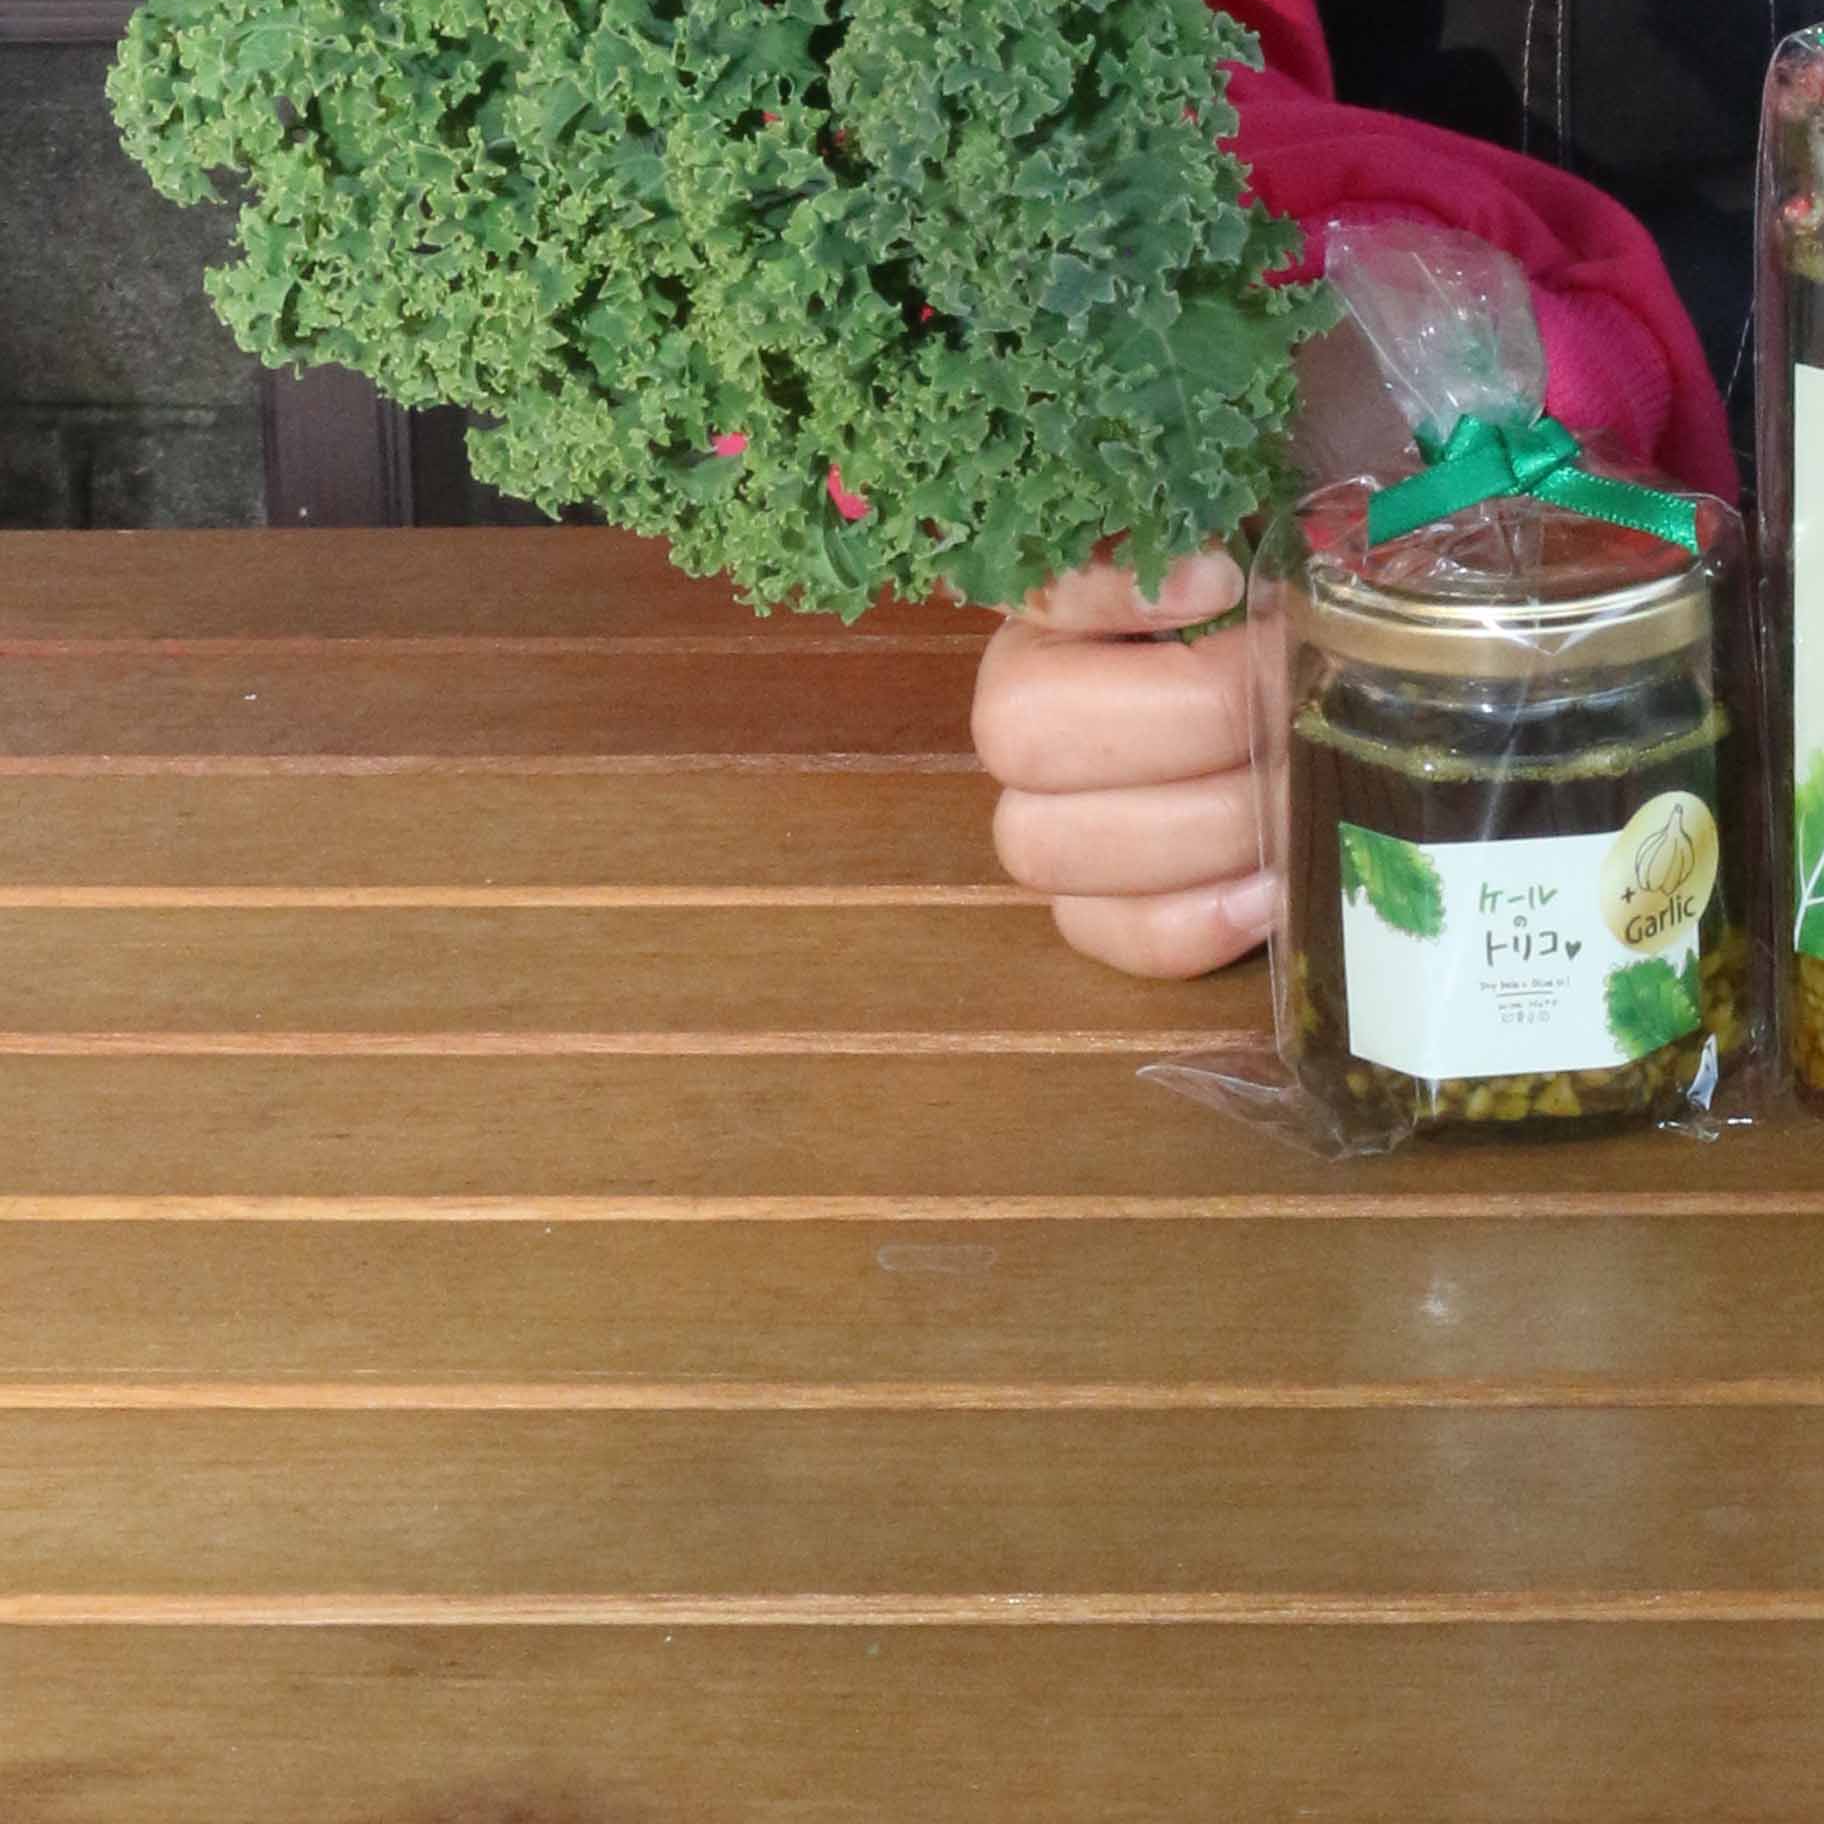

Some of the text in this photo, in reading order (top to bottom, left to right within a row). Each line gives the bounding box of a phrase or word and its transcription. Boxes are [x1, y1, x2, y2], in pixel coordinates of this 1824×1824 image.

[1479, 882, 1558, 913] ケール
[1512, 915, 1528, 928] の
[1624, 895, 1698, 945] Garlic
[1486, 930, 1558, 966] トリコ
